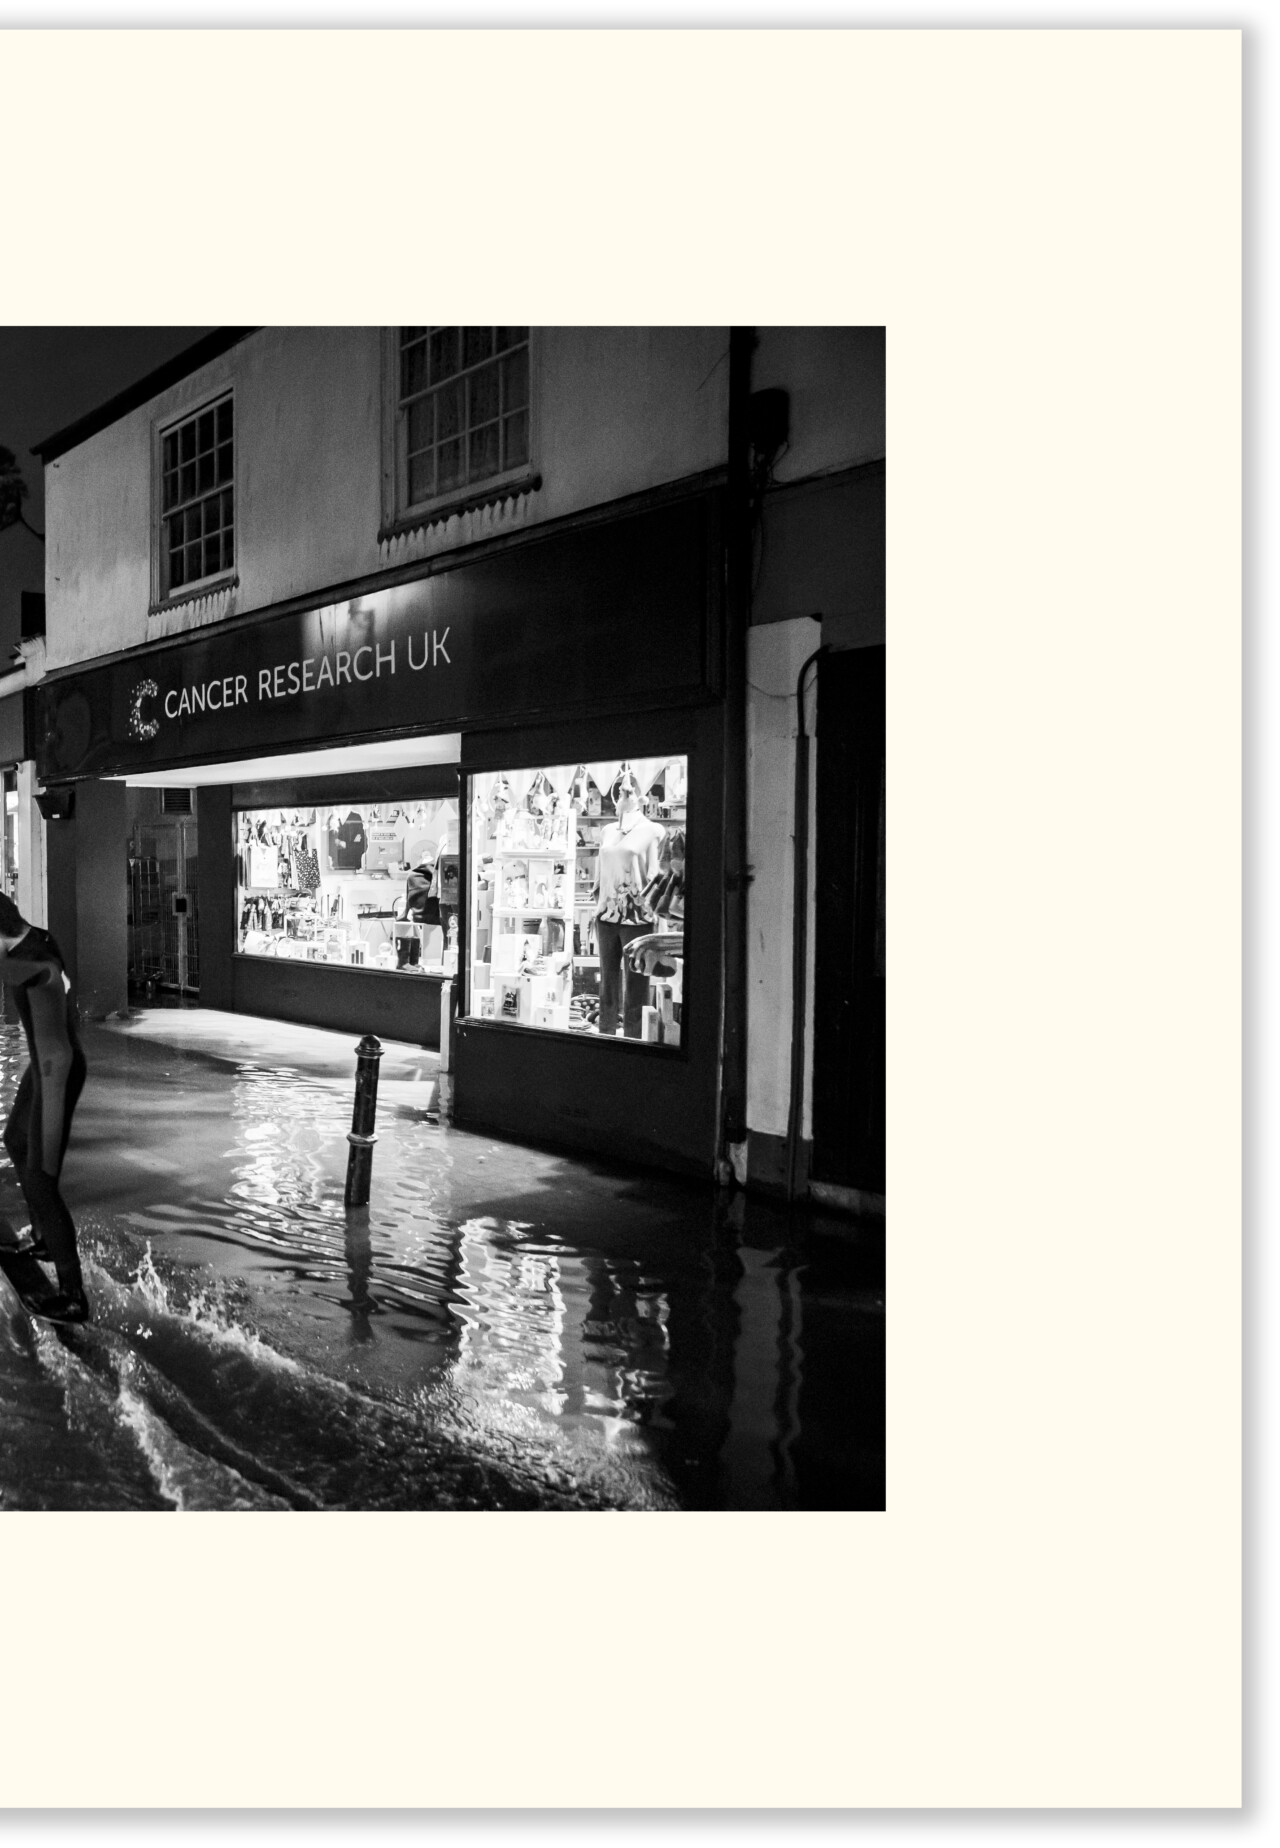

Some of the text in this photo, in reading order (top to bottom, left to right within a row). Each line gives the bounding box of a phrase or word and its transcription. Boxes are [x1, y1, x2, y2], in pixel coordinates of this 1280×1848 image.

[164, 675, 248, 718] CANCER
[258, 639, 396, 701] RESEARCH
[408, 626, 452, 670] UK
